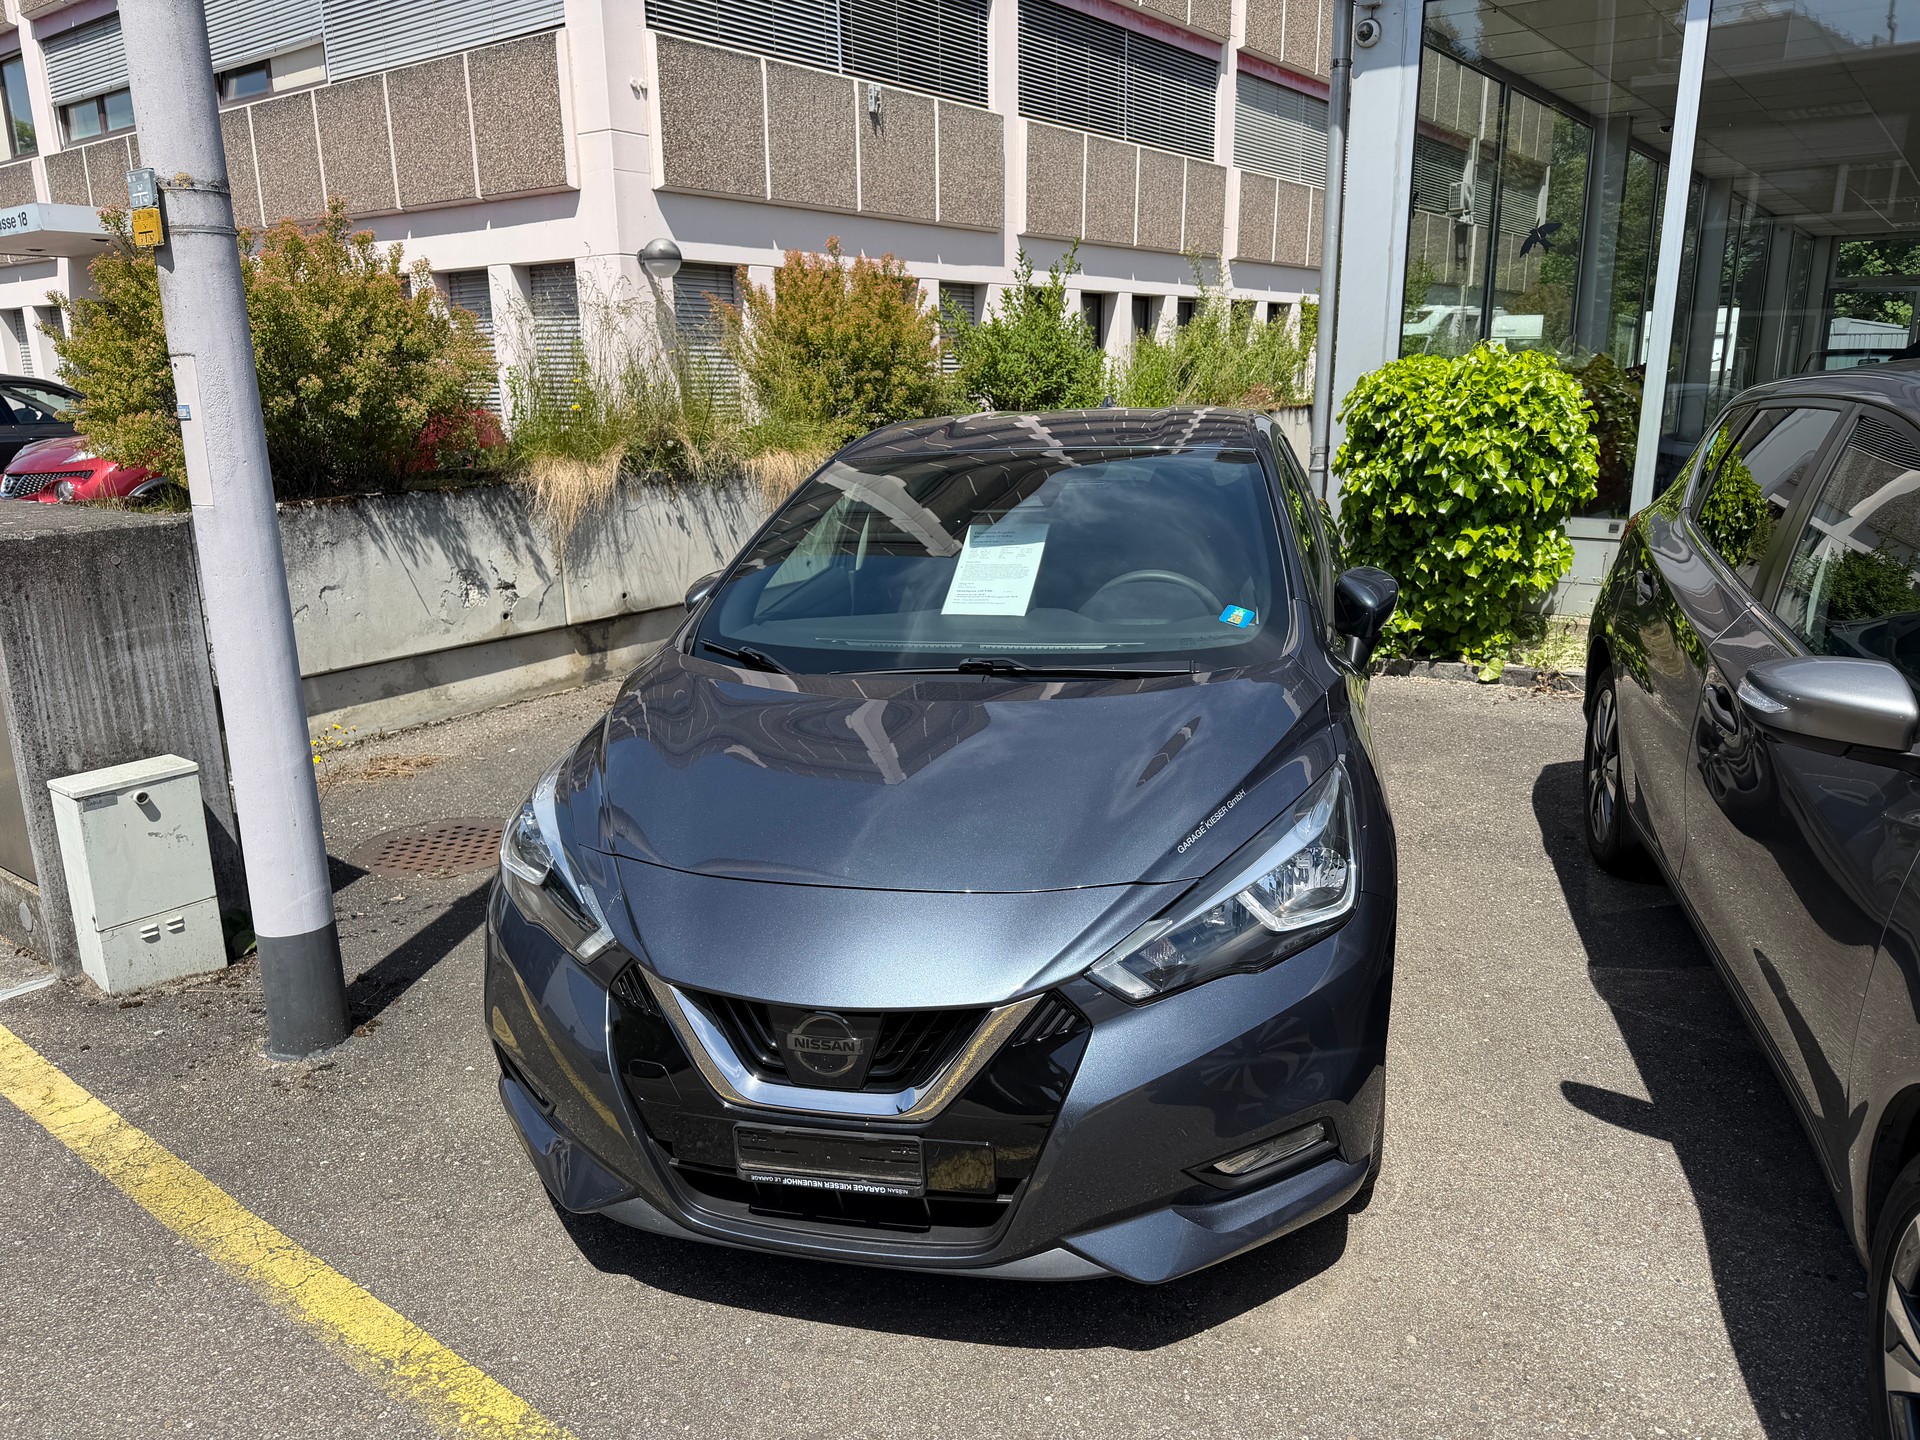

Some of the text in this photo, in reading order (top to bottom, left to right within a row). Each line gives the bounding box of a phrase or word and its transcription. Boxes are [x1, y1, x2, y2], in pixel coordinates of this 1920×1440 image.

[17, 211, 28, 227] 18
[1177, 788, 1247, 854] GARAGE KIESER GmbH
[794, 1037, 855, 1052] NISSAN
[782, 1177, 823, 1188] NEUENHOF
[824, 1181, 852, 1191] KIESER
[853, 1184, 886, 1194] GARAGE
